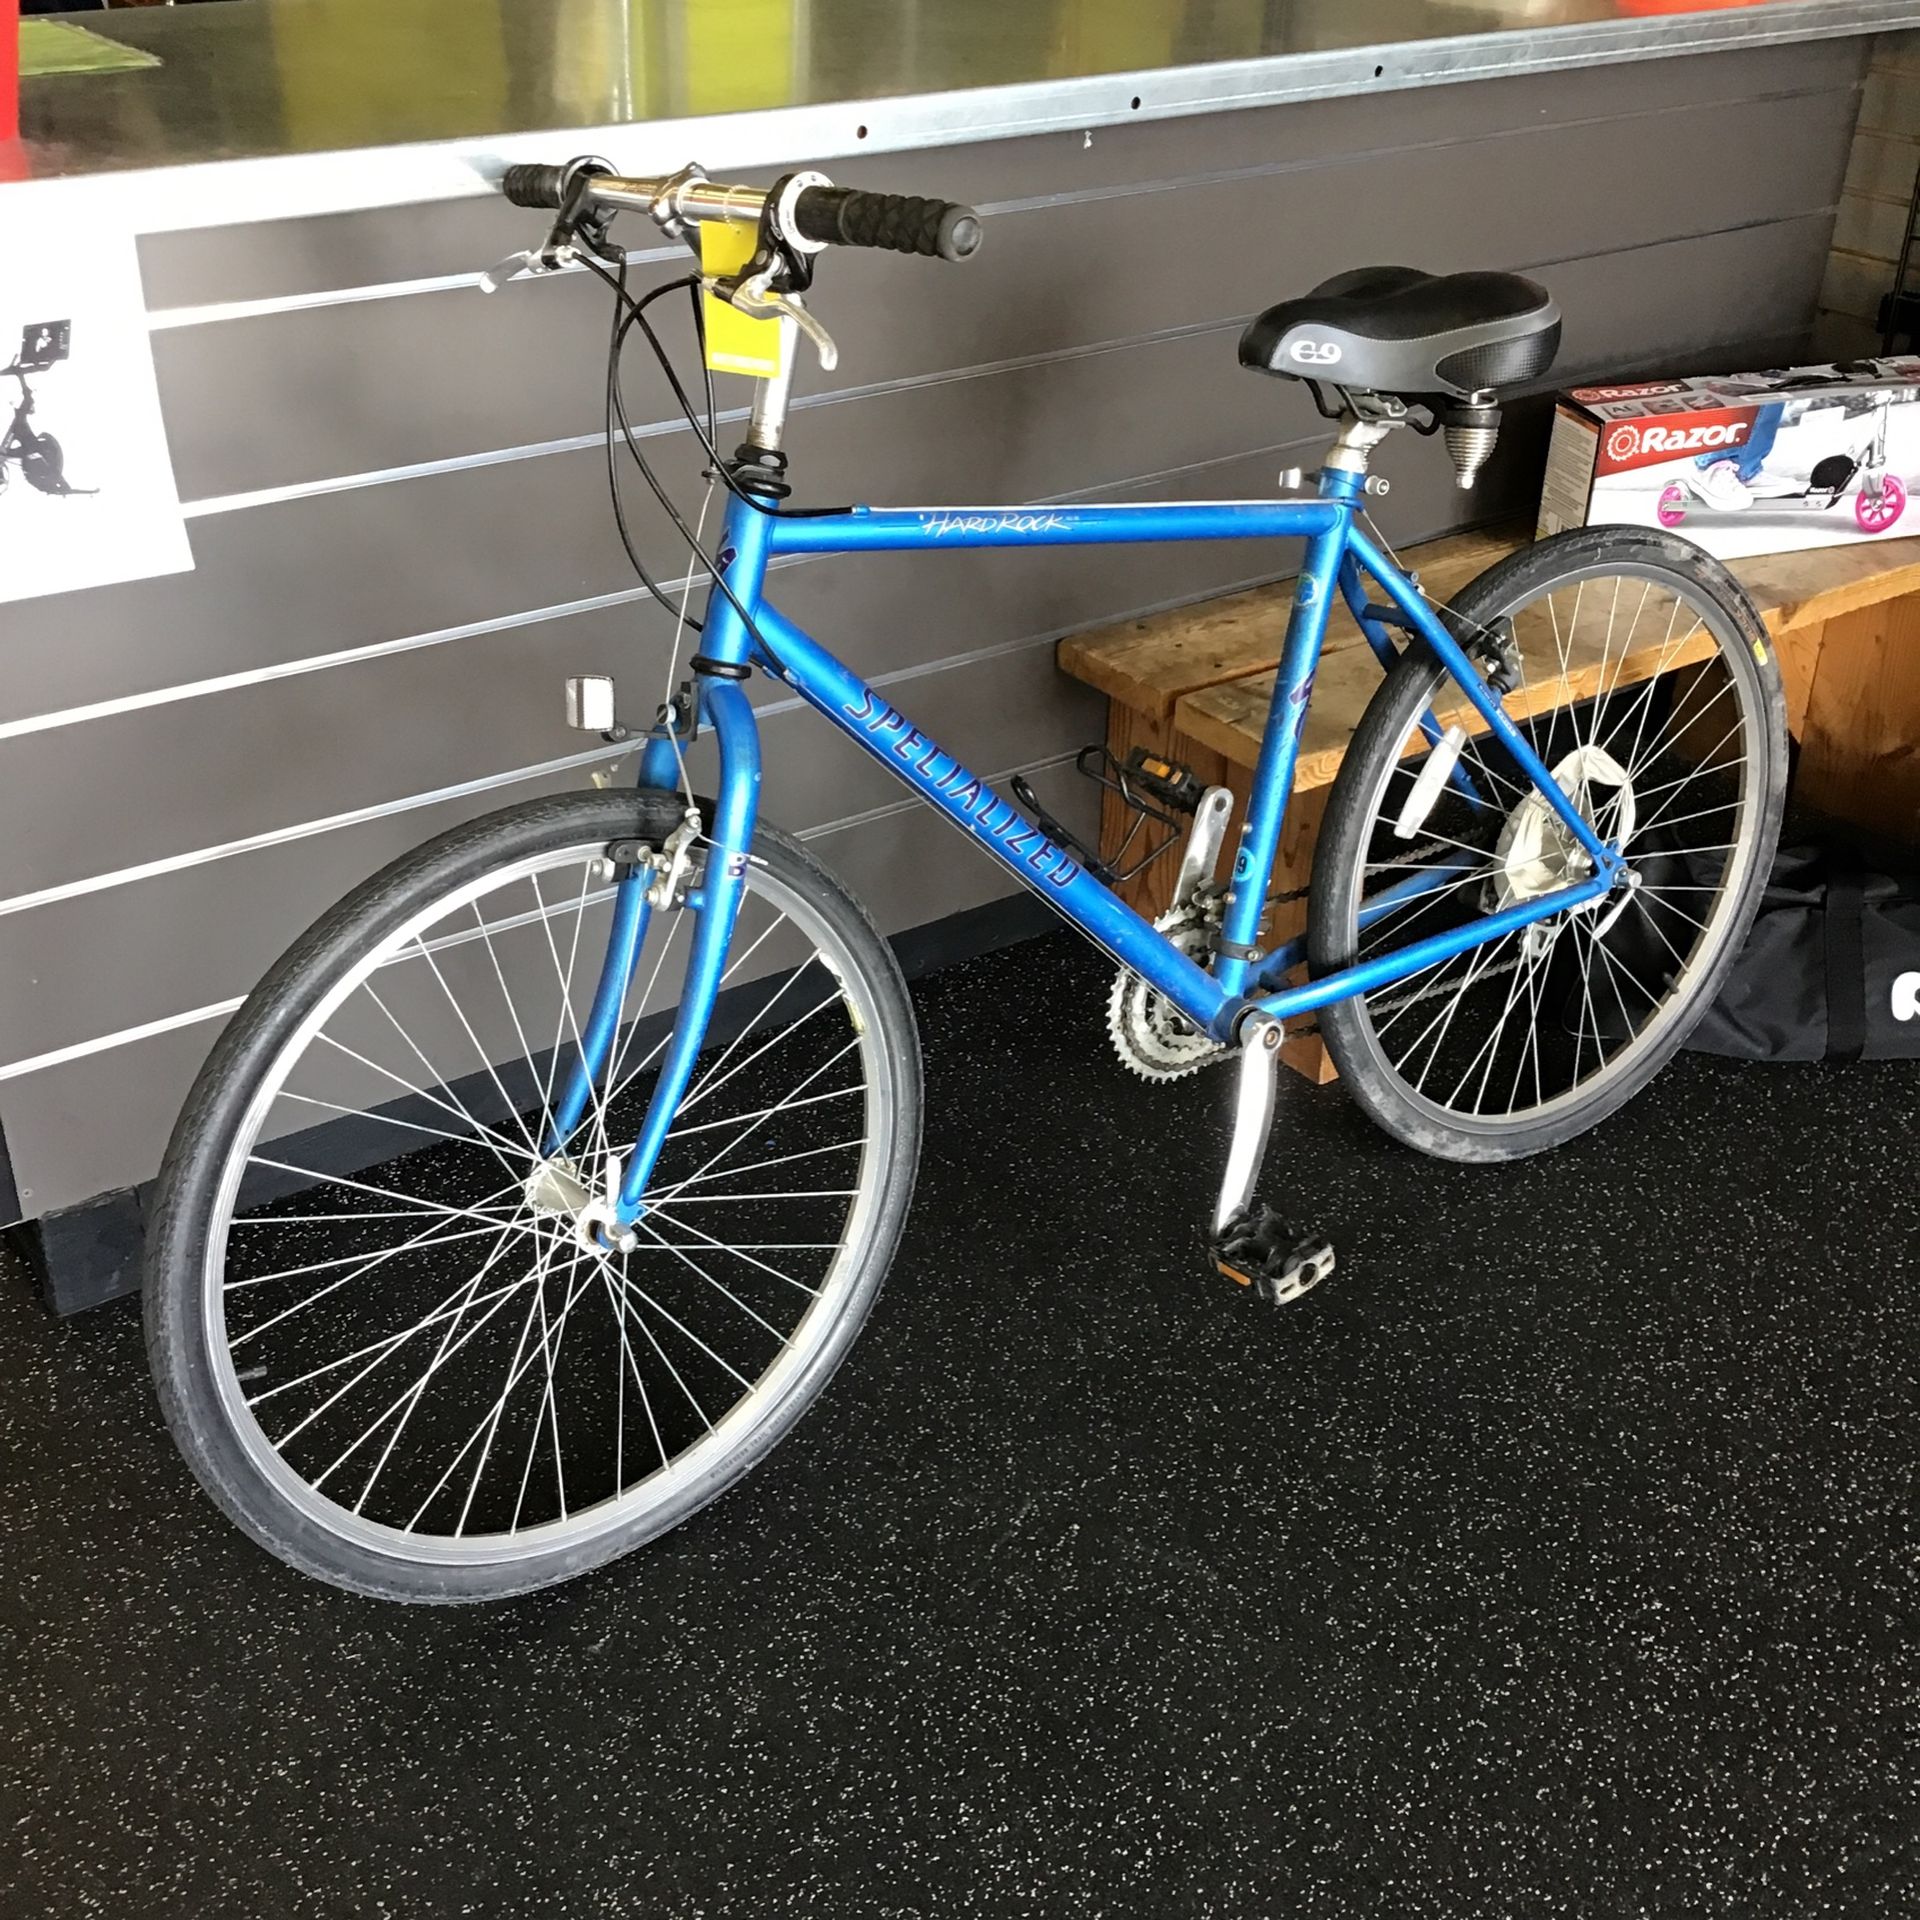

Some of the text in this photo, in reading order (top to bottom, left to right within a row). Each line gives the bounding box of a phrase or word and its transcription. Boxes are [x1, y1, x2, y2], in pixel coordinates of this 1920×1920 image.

[1599, 384, 1682, 398] Razor
[843, 687, 1081, 888] SPECIALIZED
[1237, 855, 1248, 875] 9
